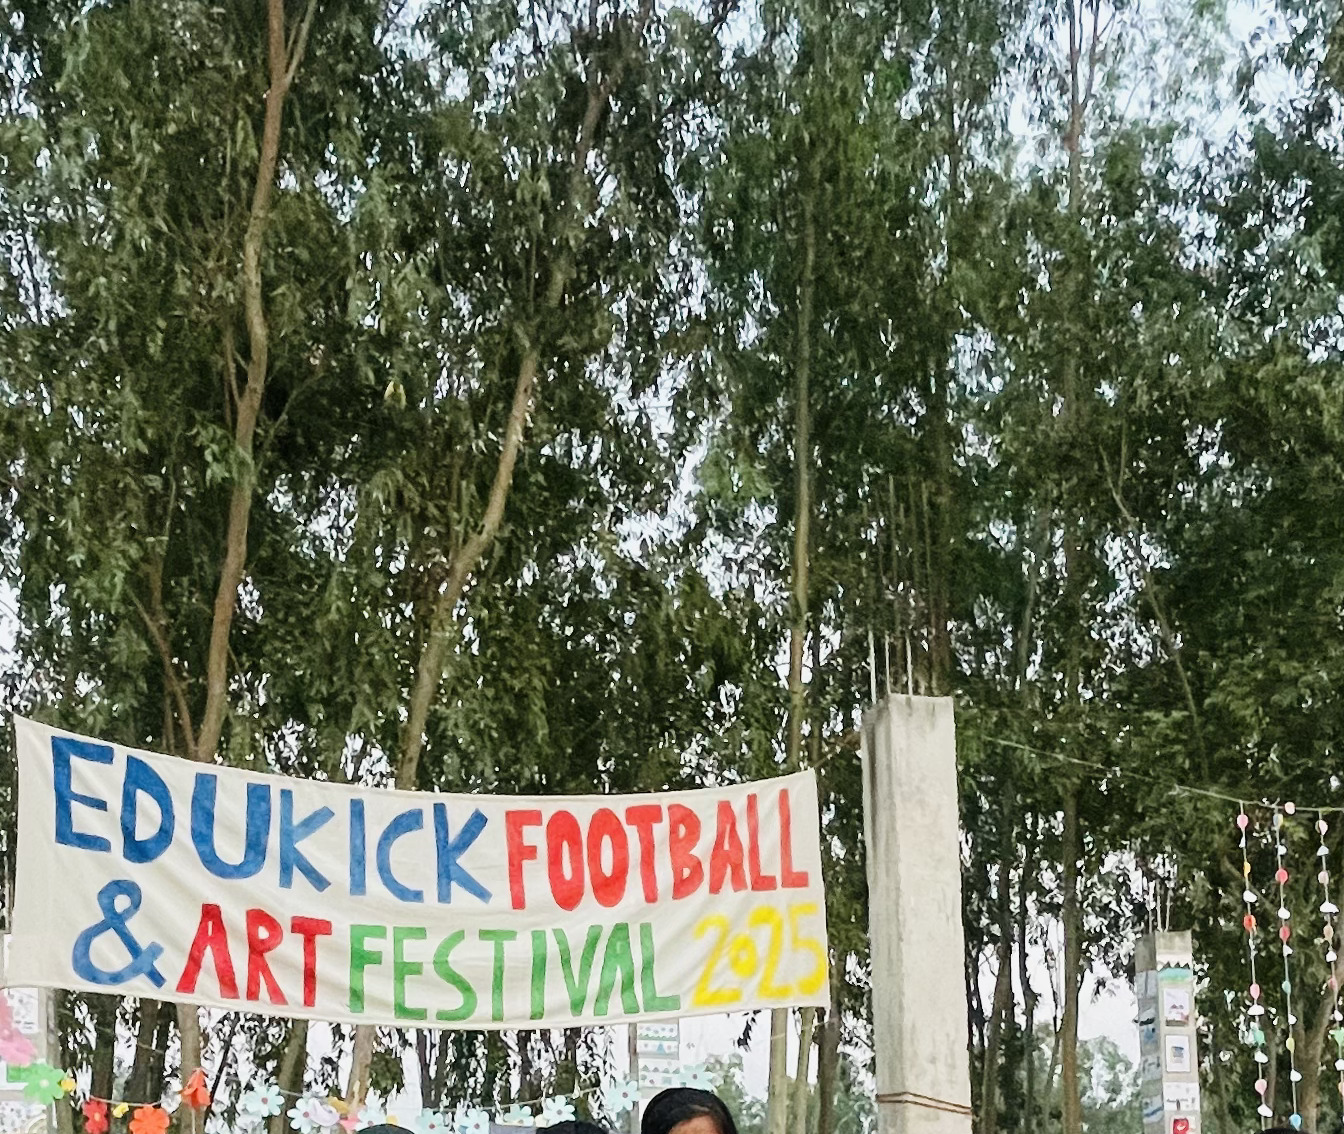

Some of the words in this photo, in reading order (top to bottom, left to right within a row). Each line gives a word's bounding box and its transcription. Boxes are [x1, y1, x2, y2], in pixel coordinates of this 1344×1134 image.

[51, 735, 493, 905] EDUKICK
[504, 788, 810, 910] FOOTBALL
[72, 879, 166, 990] &
[175, 903, 333, 1007] ART
[348, 921, 681, 1022] FESTIVAL
[693, 902, 827, 1008] 2025
